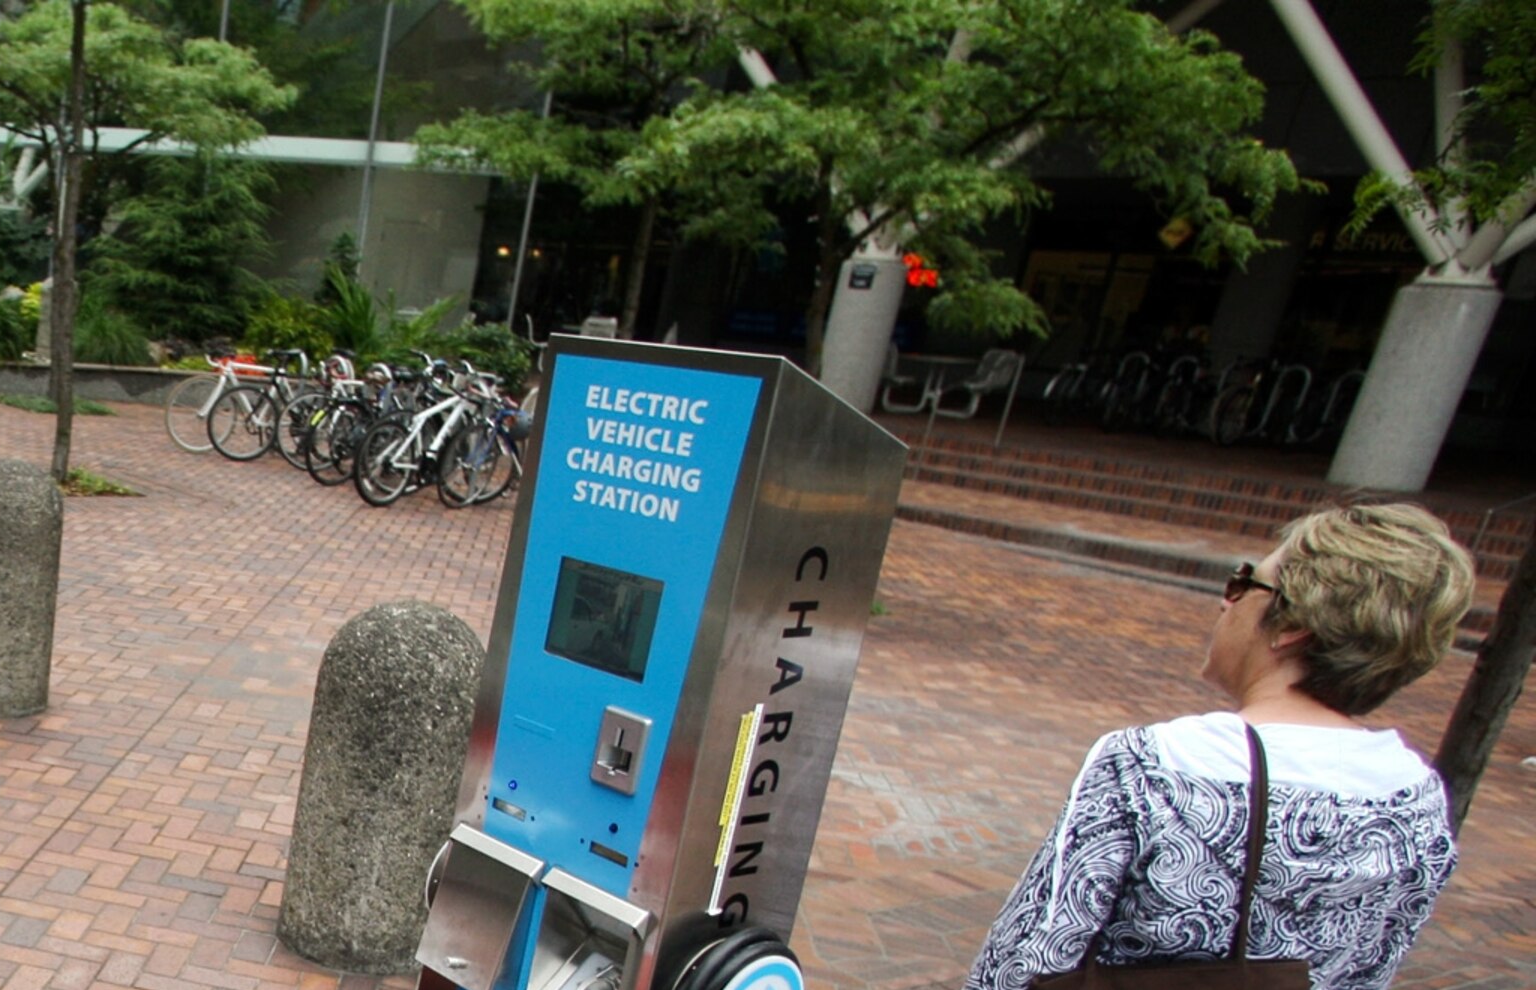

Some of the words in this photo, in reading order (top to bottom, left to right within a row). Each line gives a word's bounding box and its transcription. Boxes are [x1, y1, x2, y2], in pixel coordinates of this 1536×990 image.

[1333, 229, 1414, 253] SERVIC
[585, 384, 709, 425] ELECTRIC
[586, 416, 694, 457] VEHICLE
[565, 446, 702, 493] CHARGING
[572, 480, 680, 523] STATION
[718, 545, 829, 929] CHARGING
